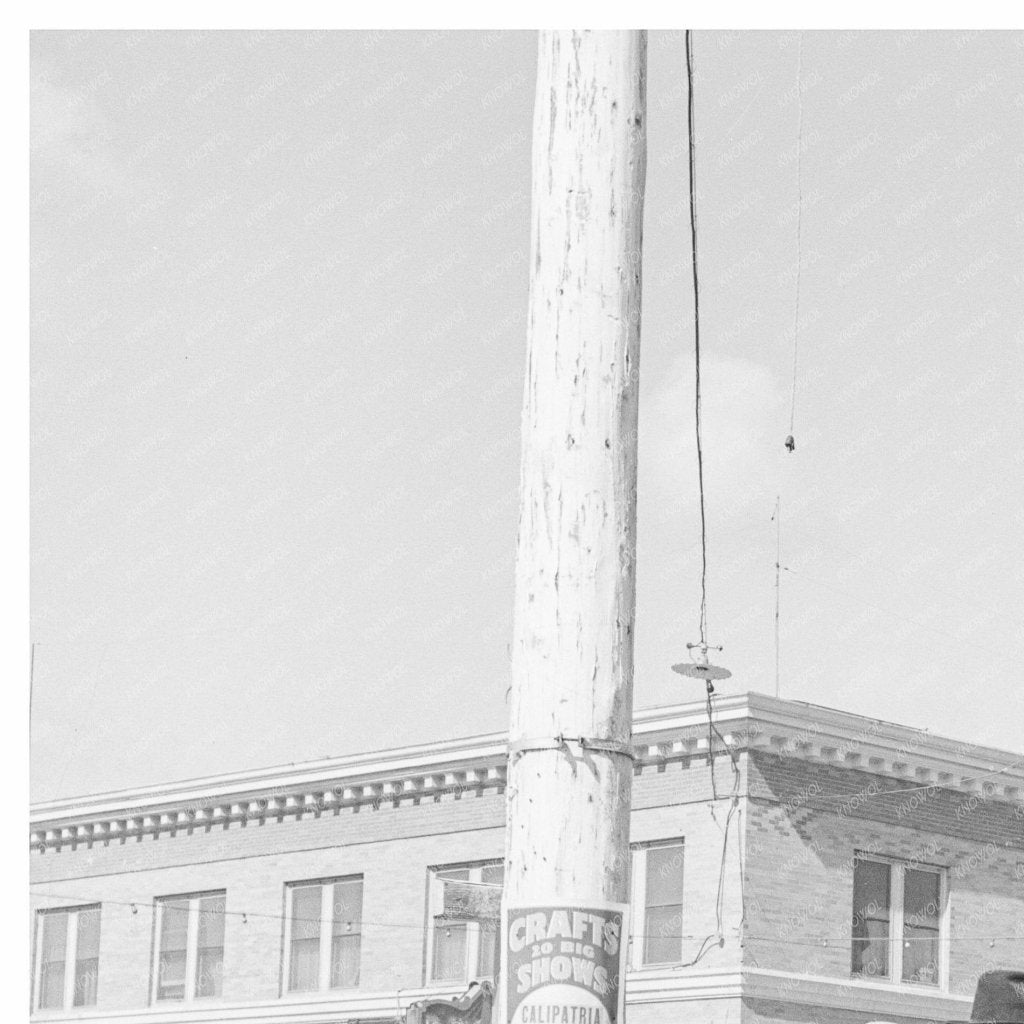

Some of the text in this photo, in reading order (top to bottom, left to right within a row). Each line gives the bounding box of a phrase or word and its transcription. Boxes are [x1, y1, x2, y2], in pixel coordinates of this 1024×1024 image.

[509, 910, 620, 956] CRAFTS
[532, 941, 596, 959] 20 BIG
[516, 956, 608, 996] SHOWS
